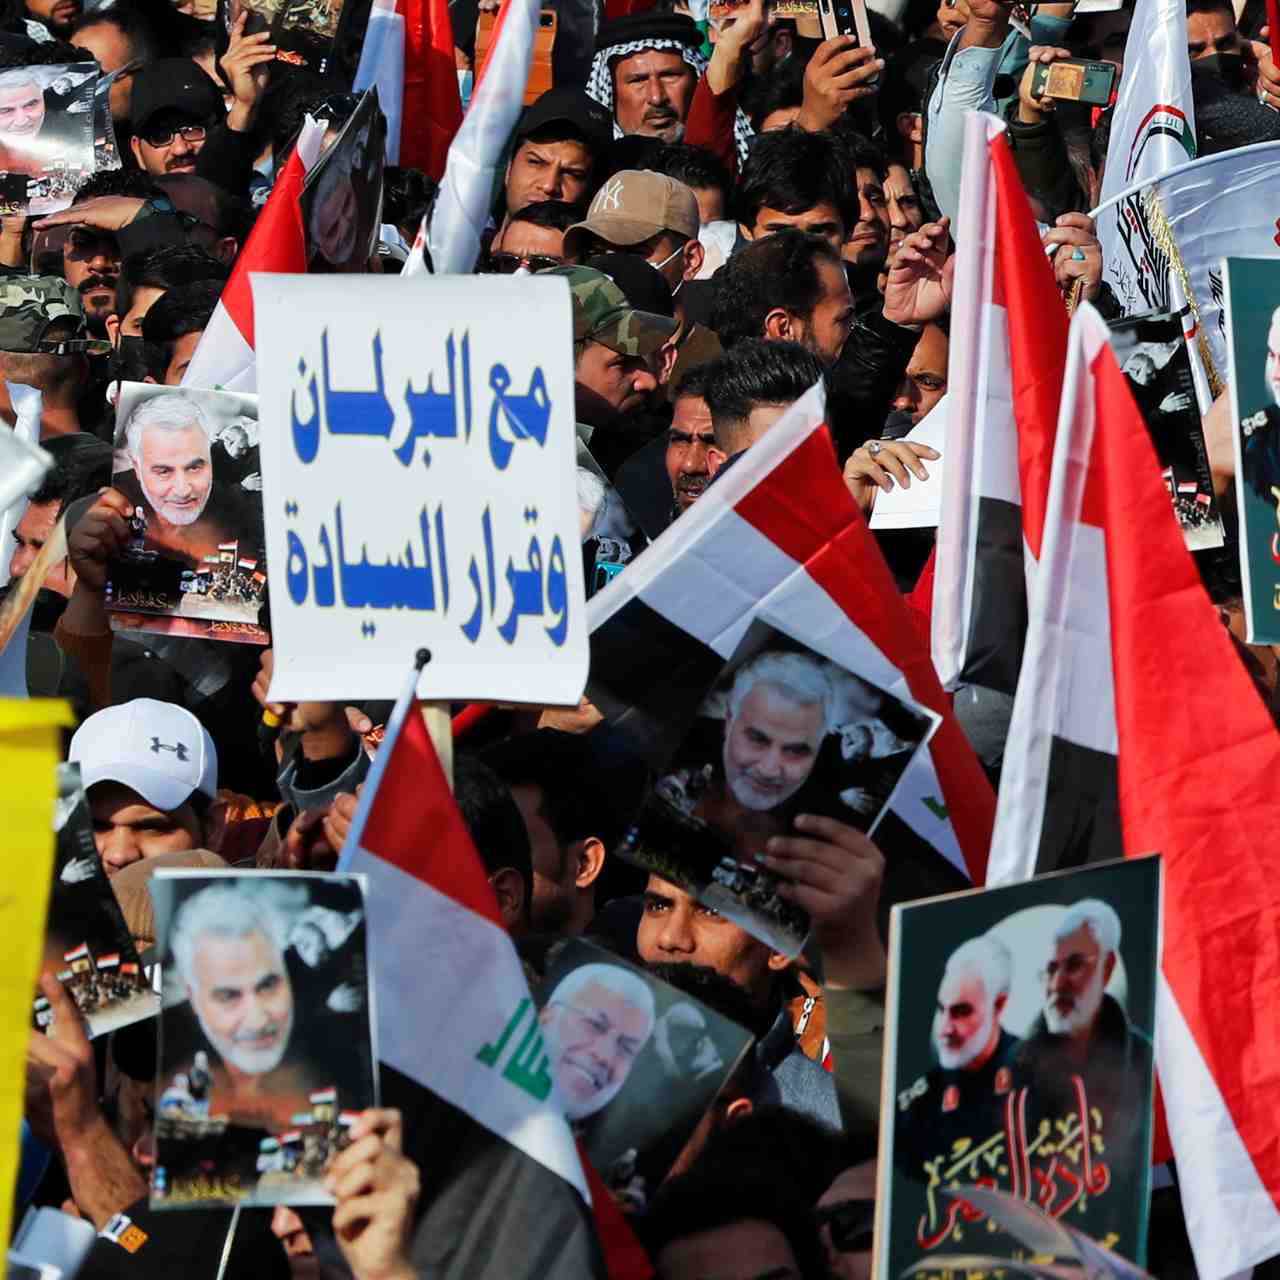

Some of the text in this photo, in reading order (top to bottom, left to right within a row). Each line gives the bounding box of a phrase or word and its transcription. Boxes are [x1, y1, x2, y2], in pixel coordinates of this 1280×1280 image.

[290, 326, 553, 470] مع البرلمان
[286, 500, 571, 649] وقرار السيادة
